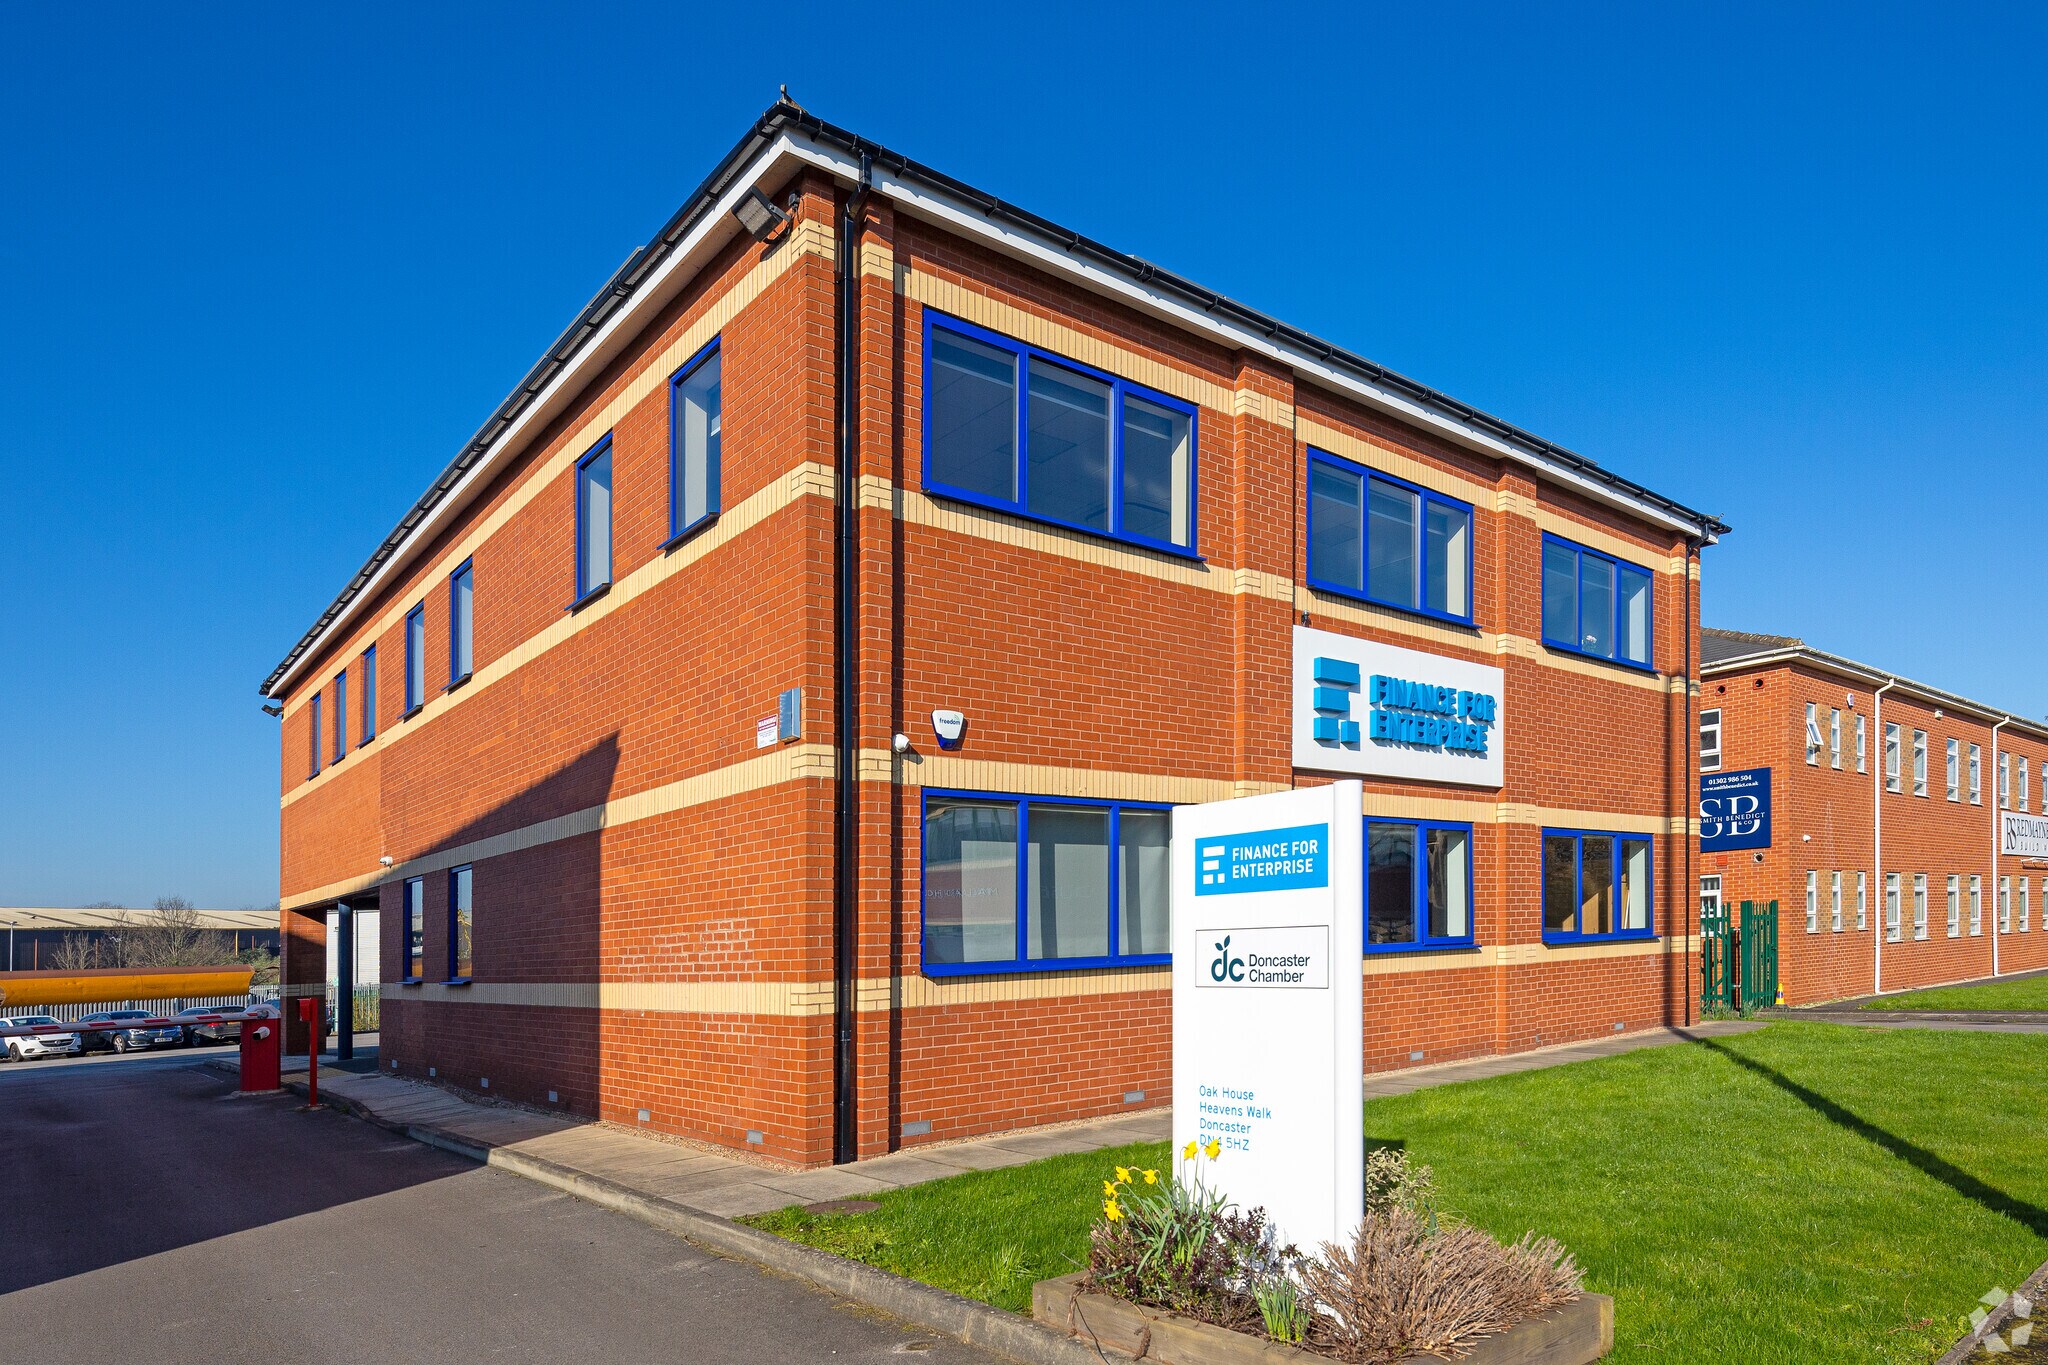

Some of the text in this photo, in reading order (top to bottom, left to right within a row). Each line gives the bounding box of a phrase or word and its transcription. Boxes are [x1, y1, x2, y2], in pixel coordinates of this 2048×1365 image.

[1370, 675, 1497, 722] FINANCE FOR
[939, 717, 961, 726] freedom
[1370, 710, 1488, 751] ENTERPRISE
[1708, 777, 1727, 785] 01302
[1740, 774, 1752, 782] 504
[1726, 812, 1765, 821] BENEDICT
[1232, 839, 1319, 862] FINANCE FOR
[1232, 858, 1314, 879] ENTERPRISE
[1249, 954, 1310, 967] Doncaster
[1249, 969, 1304, 983] Chamber
[1199, 1085, 1254, 1101] Oak House
[1199, 1101, 1272, 1119] Heavens Walk
[1199, 1118, 1251, 1134] Doncaster
[1226, 1136, 1250, 1151] 5HZ
